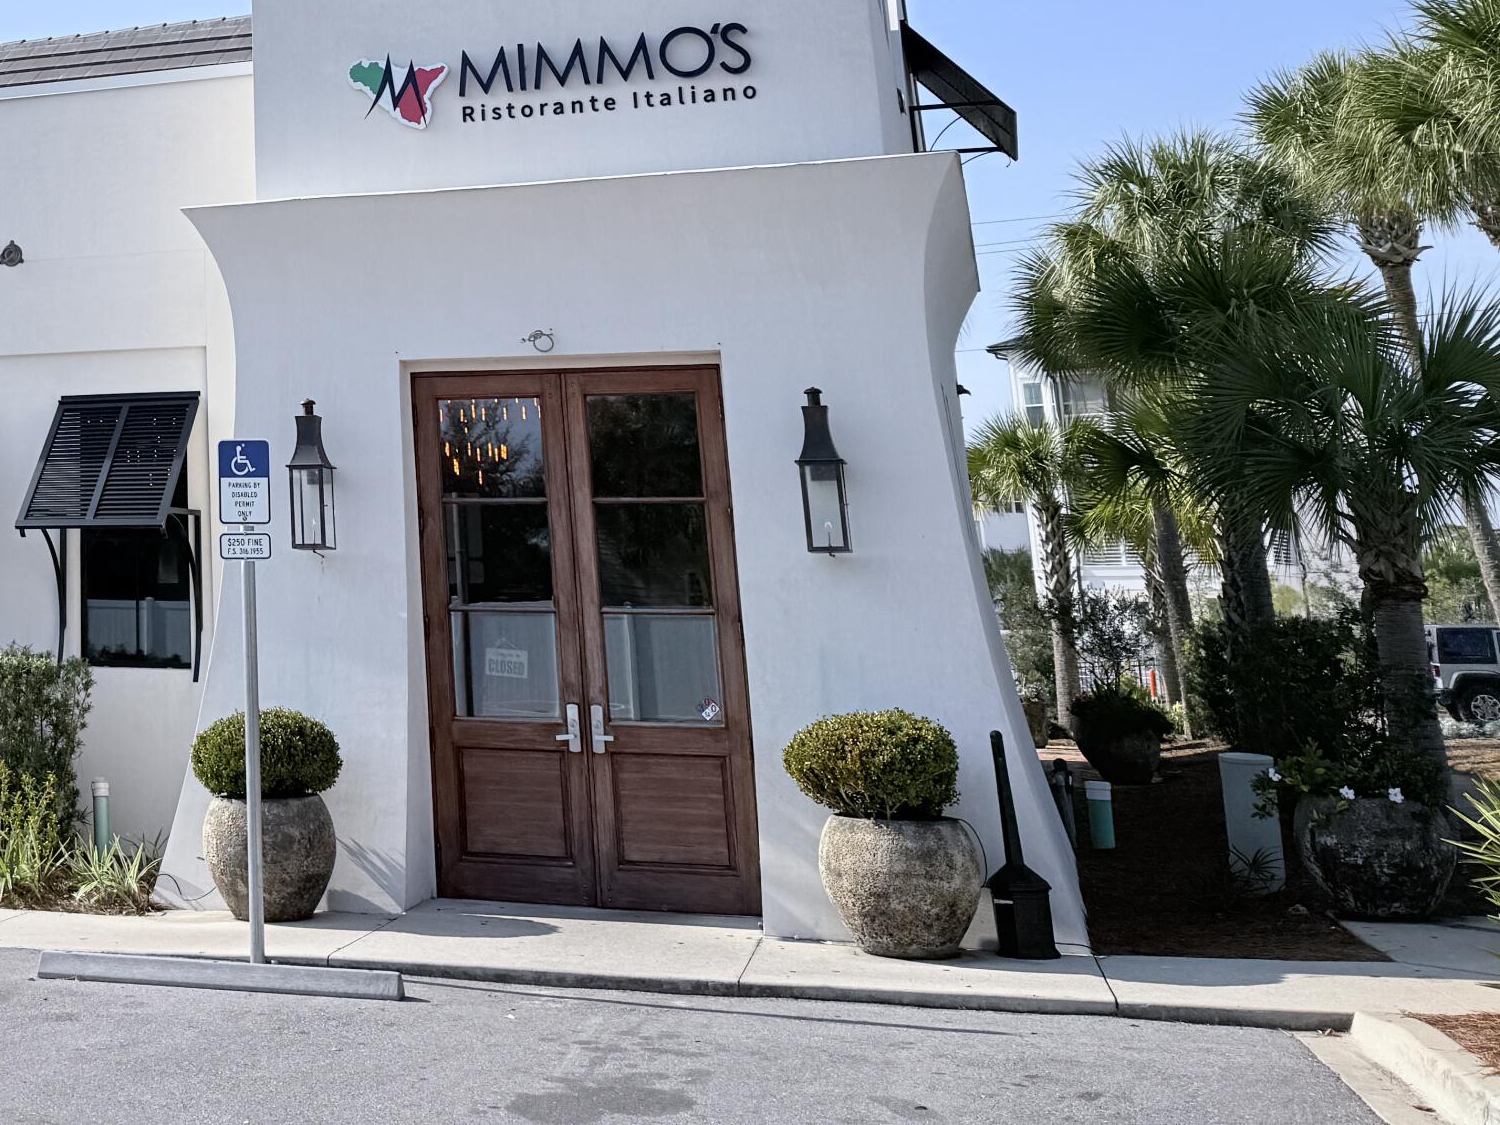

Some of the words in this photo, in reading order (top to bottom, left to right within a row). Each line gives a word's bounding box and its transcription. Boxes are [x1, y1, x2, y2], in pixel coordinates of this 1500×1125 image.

[458, 22, 752, 97] MIMMO'S
[462, 95, 617, 123] Ristorante
[632, 84, 758, 109] Italiano
[228, 538, 245, 547] $250
[247, 538, 263, 546] FINE
